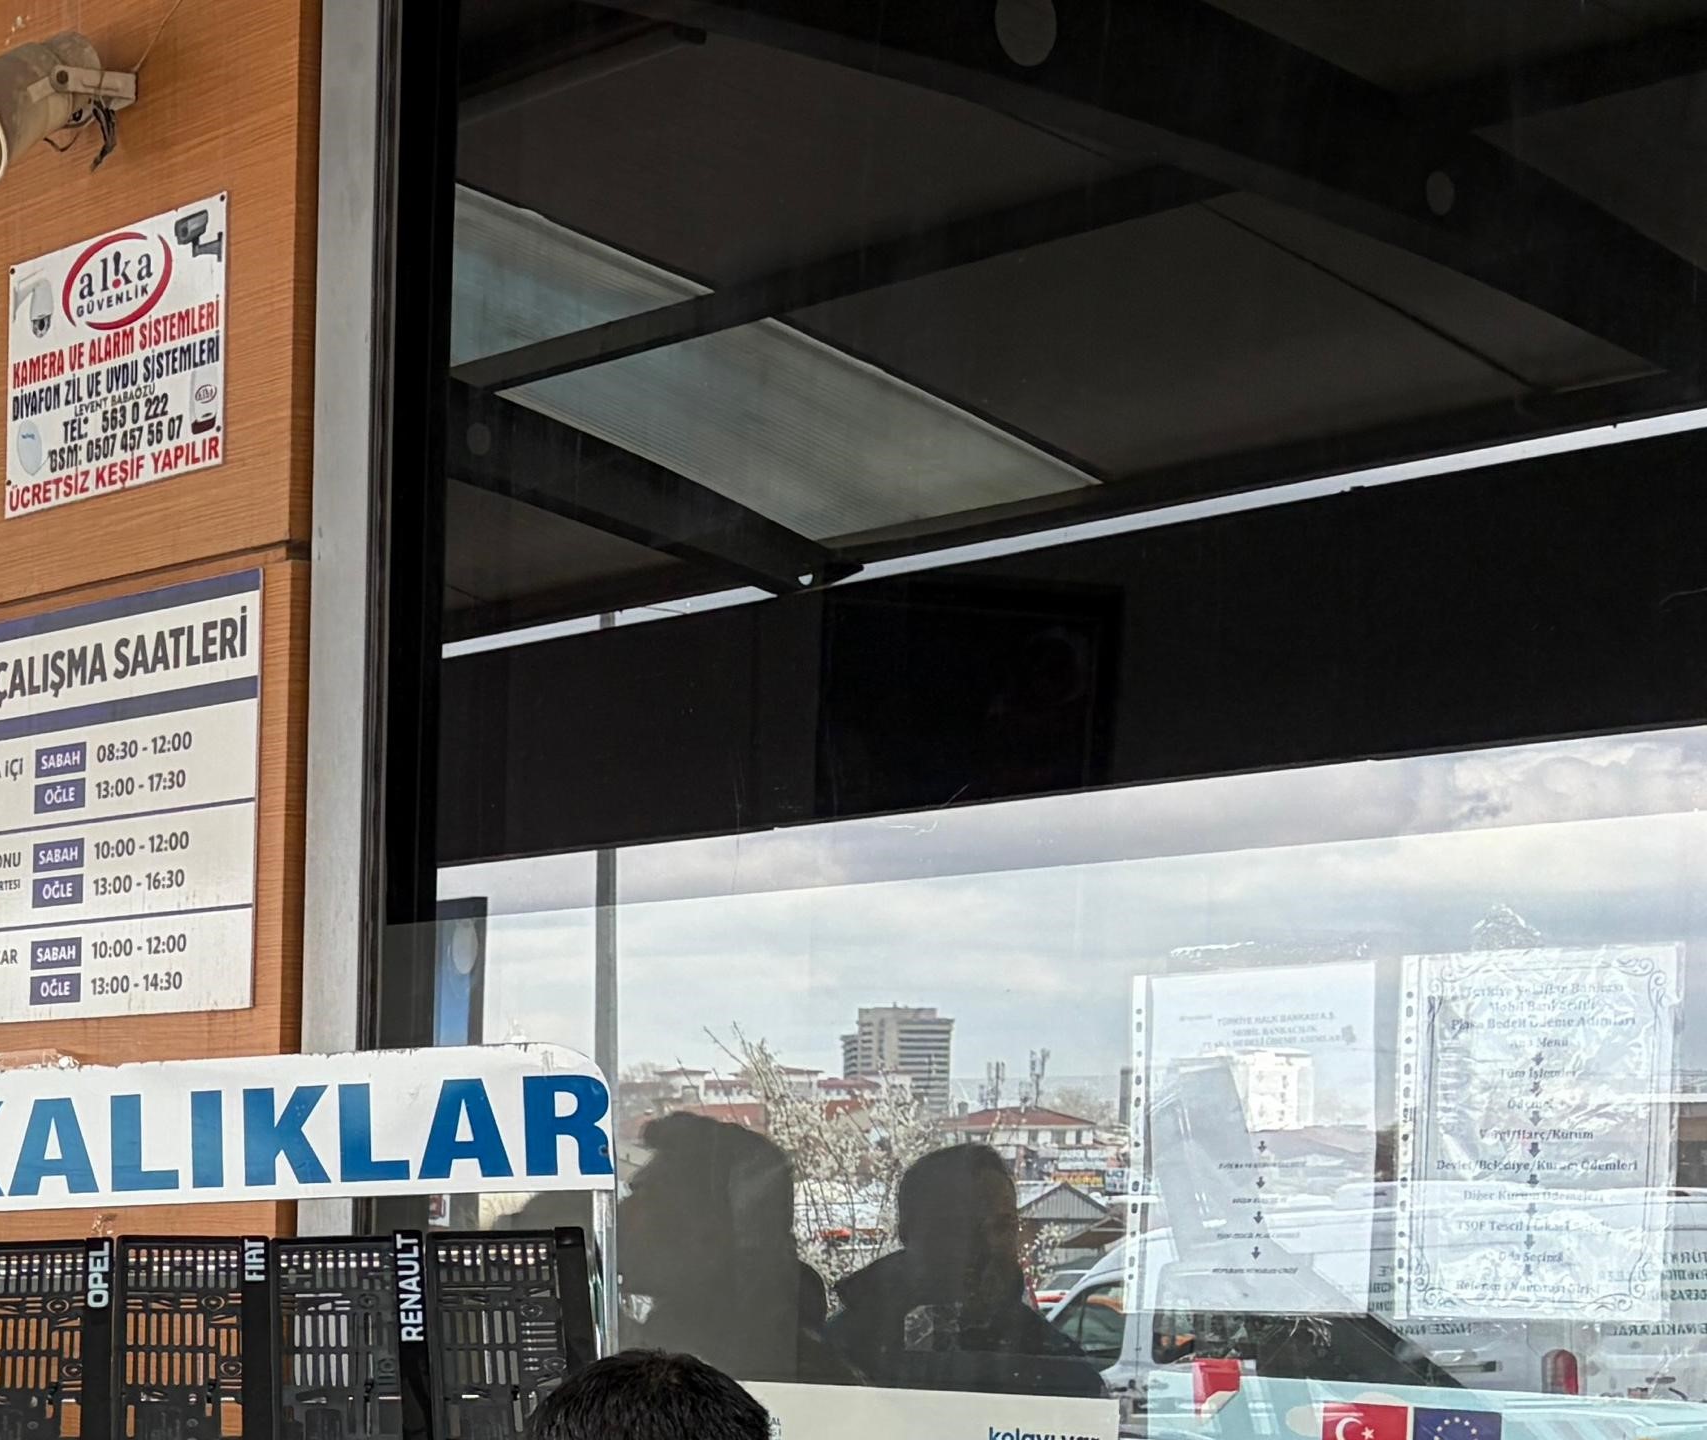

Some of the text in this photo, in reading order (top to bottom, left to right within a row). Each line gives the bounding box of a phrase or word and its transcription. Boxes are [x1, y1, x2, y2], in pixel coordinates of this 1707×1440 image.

[77, 283, 149, 318] GÜVENLİK
[13, 294, 220, 389] KAMERA VE ALARM SİSTEMLERİ
[12, 330, 220, 421] DİYAFON ZİL VE UYDU SİSTEMLERİ
[63, 393, 168, 444] TEL: 563 0 222
[74, 397, 107, 417] LEVENT
[50, 414, 183, 473] GSM: 0507 457 56 07
[9, 435, 219, 512] ÜCRETSİZ KEŞİF YAPILIR
[114, 605, 248, 679] SAATLERİ
[41, 731, 192, 770] SABAH 08:30 12:00
[95, 779, 134, 799] 13:00
[149, 769, 186, 790] 17:30
[38, 831, 190, 866] SABAH 10:00 12:00
[93, 876, 133, 897] 13:00
[147, 869, 185, 889] 16:30
[36, 934, 187, 963] SABAH 10:00 12:00
[91, 976, 130, 996] 13:00
[143, 971, 183, 991] 14:30
[88, 1240, 110, 1309] OPEL
[244, 1238, 266, 1282] FIAT
[401, 1233, 424, 1342] RENAULT
